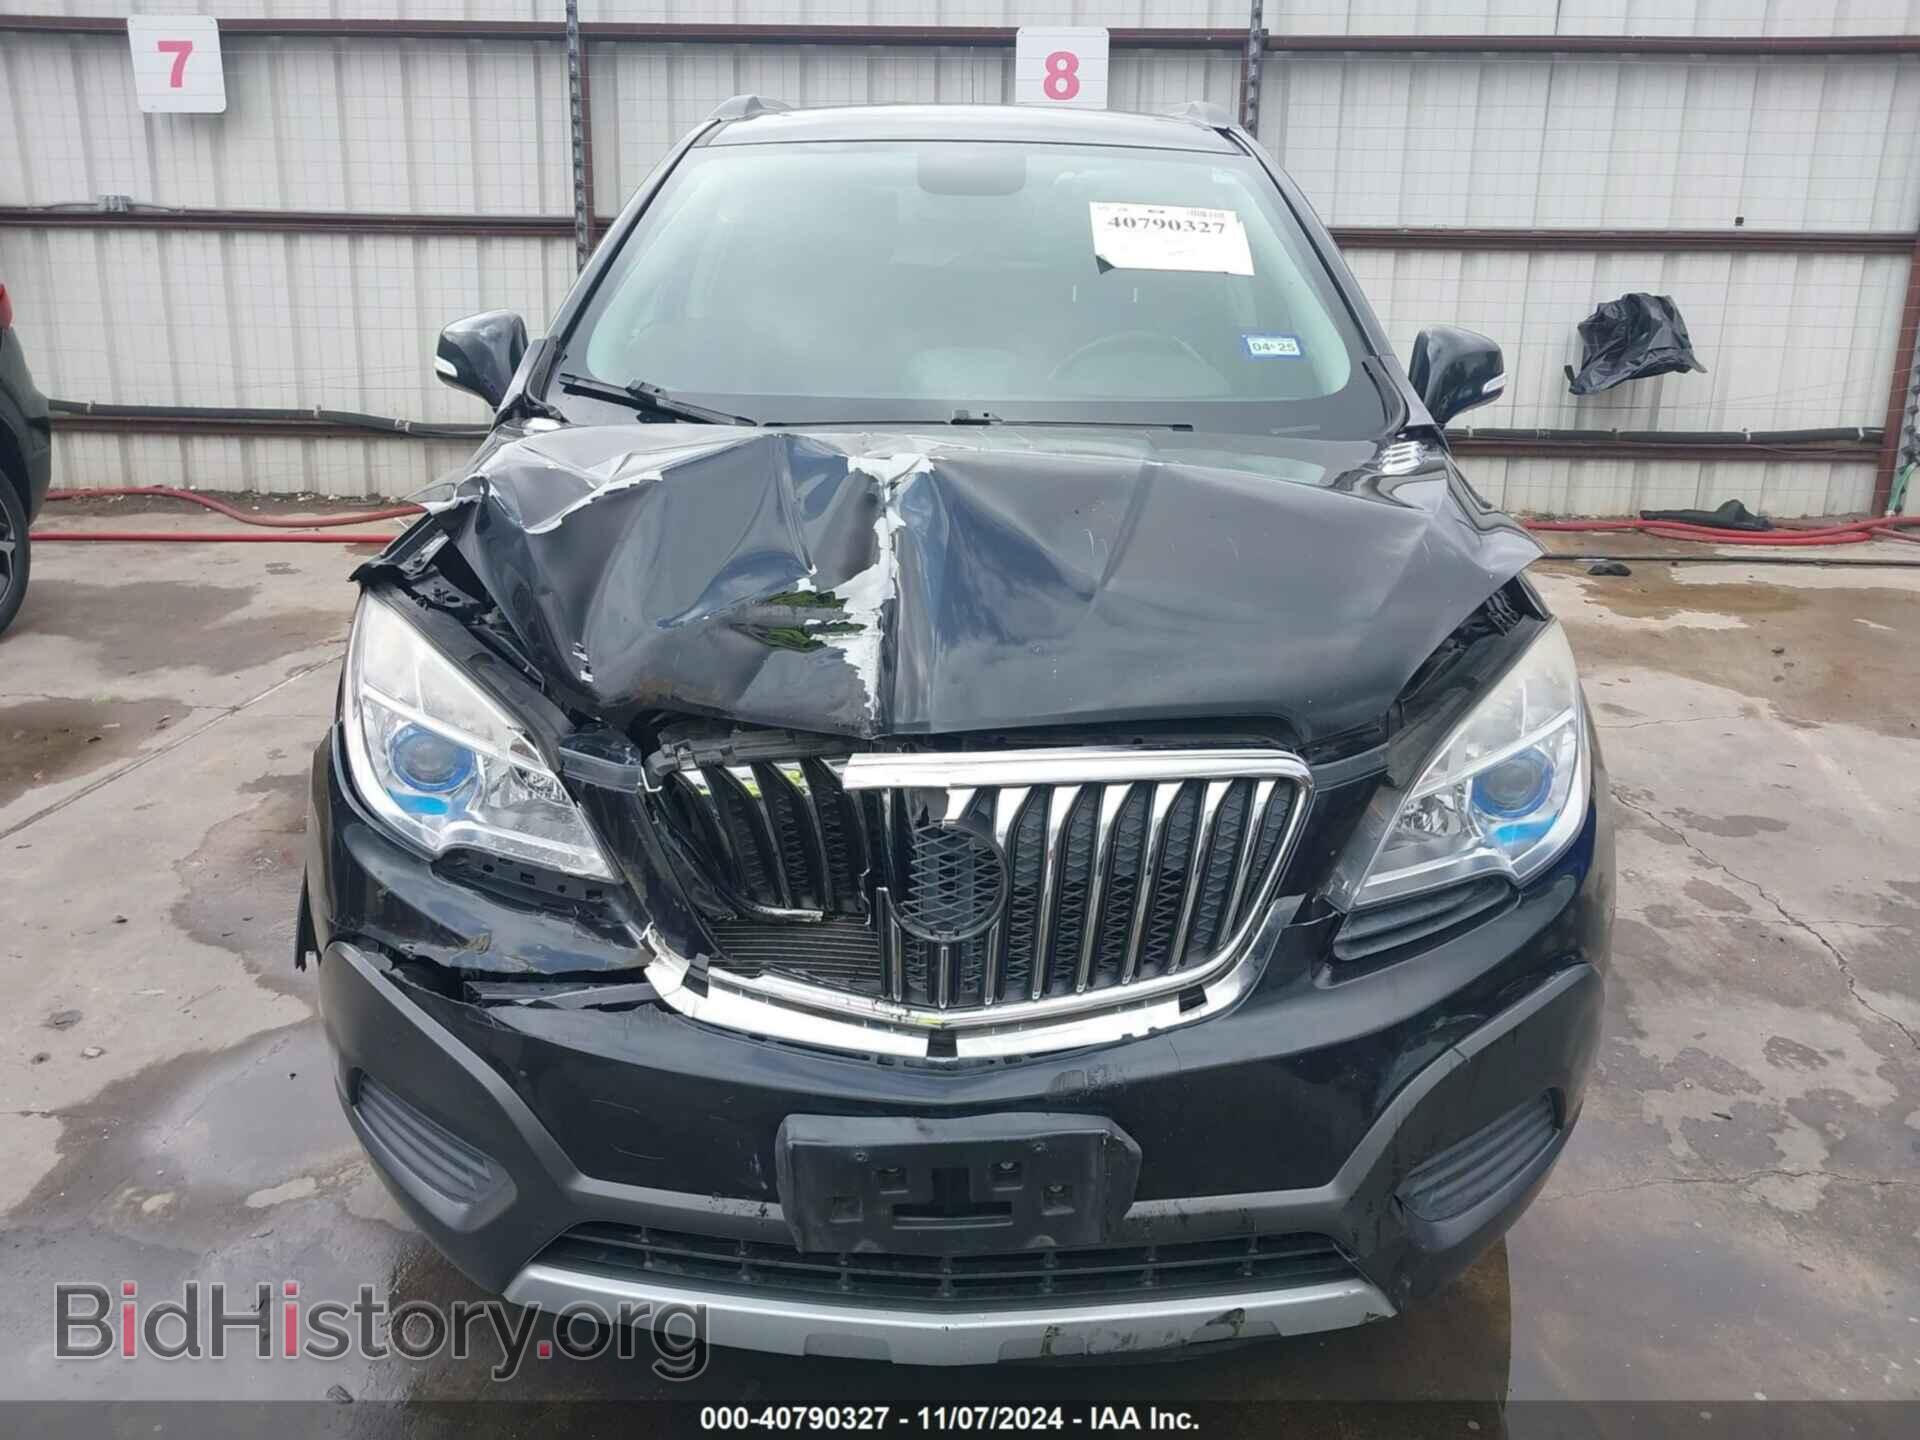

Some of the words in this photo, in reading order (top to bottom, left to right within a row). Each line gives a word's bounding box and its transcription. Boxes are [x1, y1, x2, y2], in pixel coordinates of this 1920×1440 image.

[158, 40, 193, 89] 7
[1043, 51, 1080, 100] 8
[1107, 216, 1225, 234] 40790327
